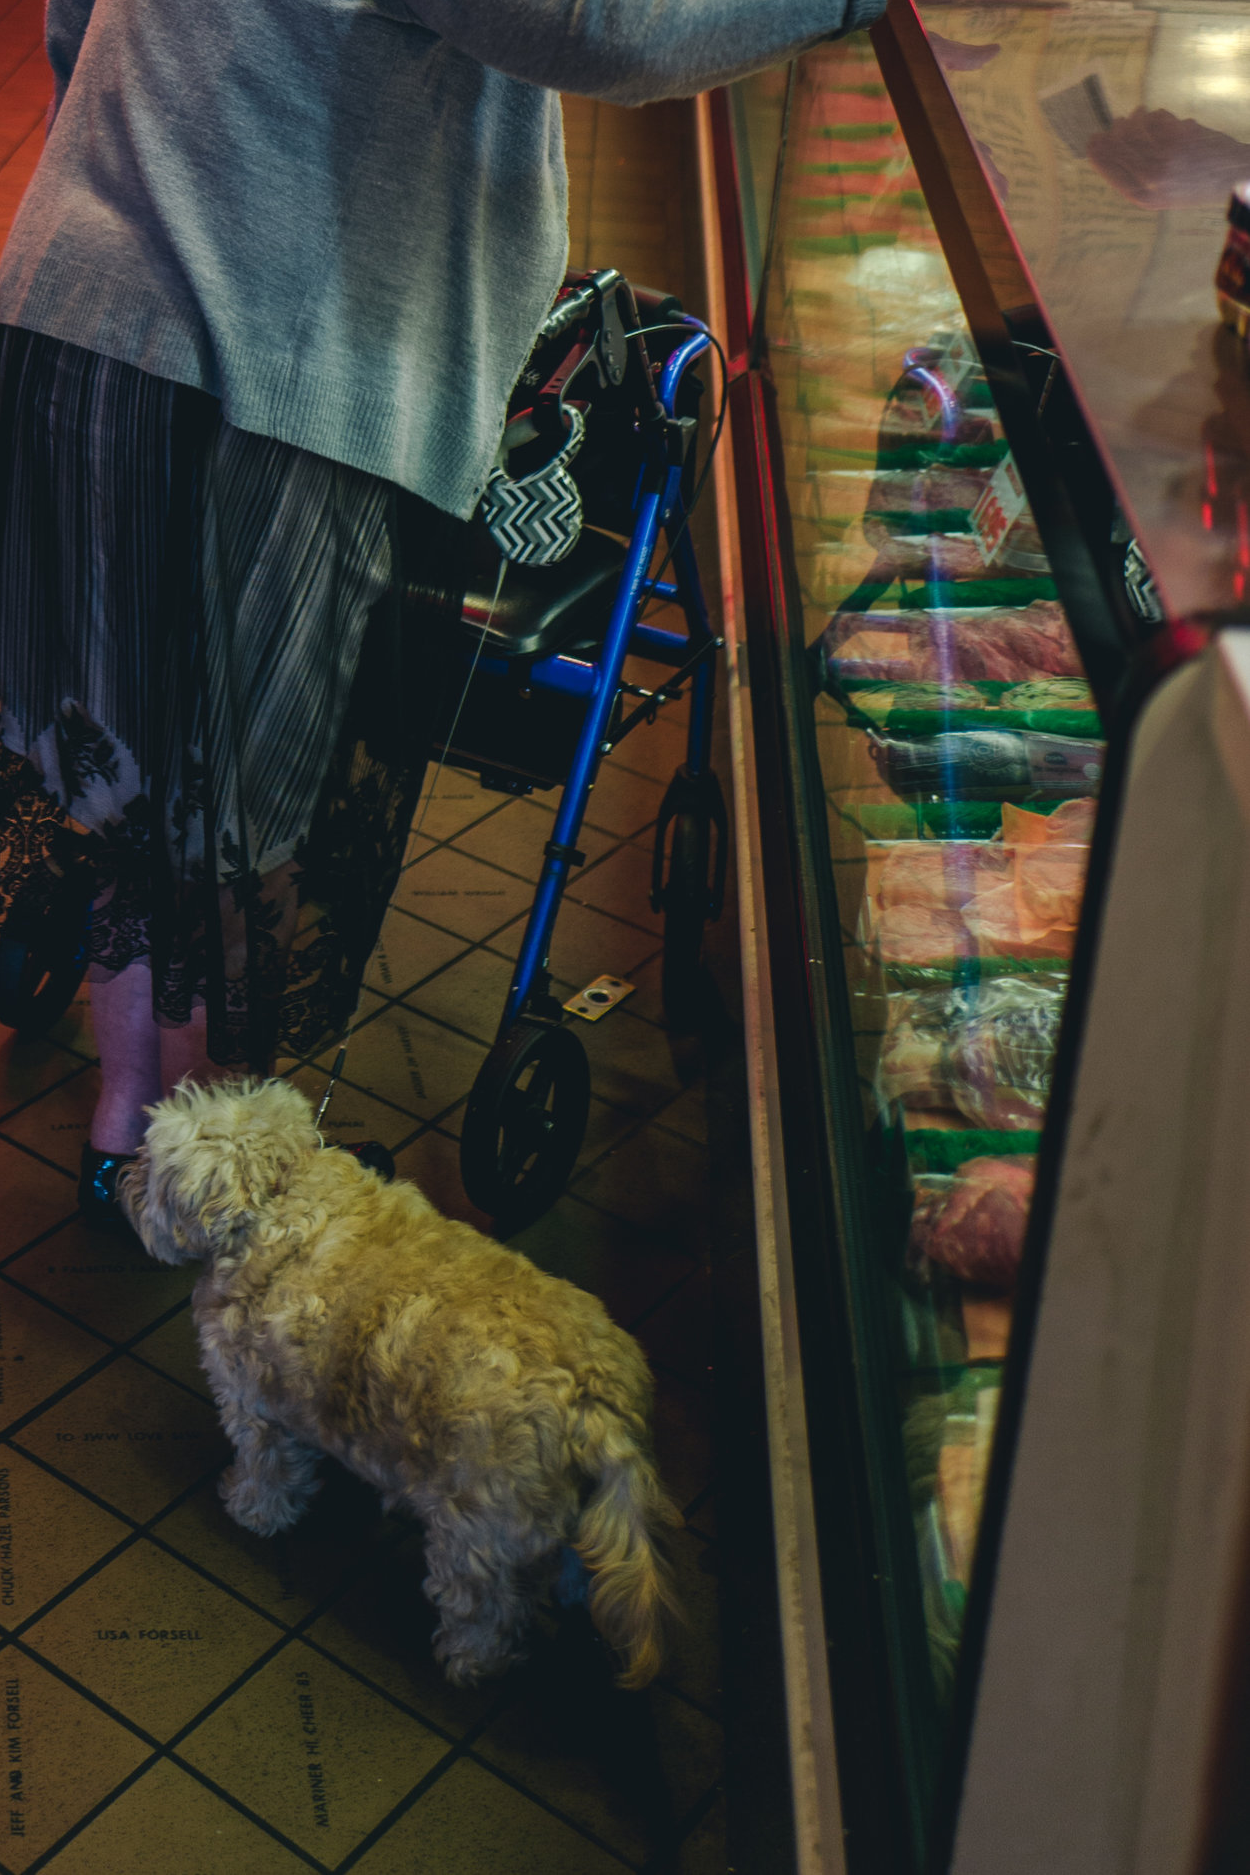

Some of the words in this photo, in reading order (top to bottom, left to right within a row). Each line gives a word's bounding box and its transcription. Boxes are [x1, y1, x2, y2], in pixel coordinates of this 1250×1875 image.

[138, 1629, 203, 1641] FORSELL
[6, 1678, 22, 1732] FORSELL
[298, 1694, 318, 1735] CHEER
[6, 1735, 23, 1765] KIM
[8, 1769, 25, 1801] AND
[307, 1762, 330, 1827] MARINER
